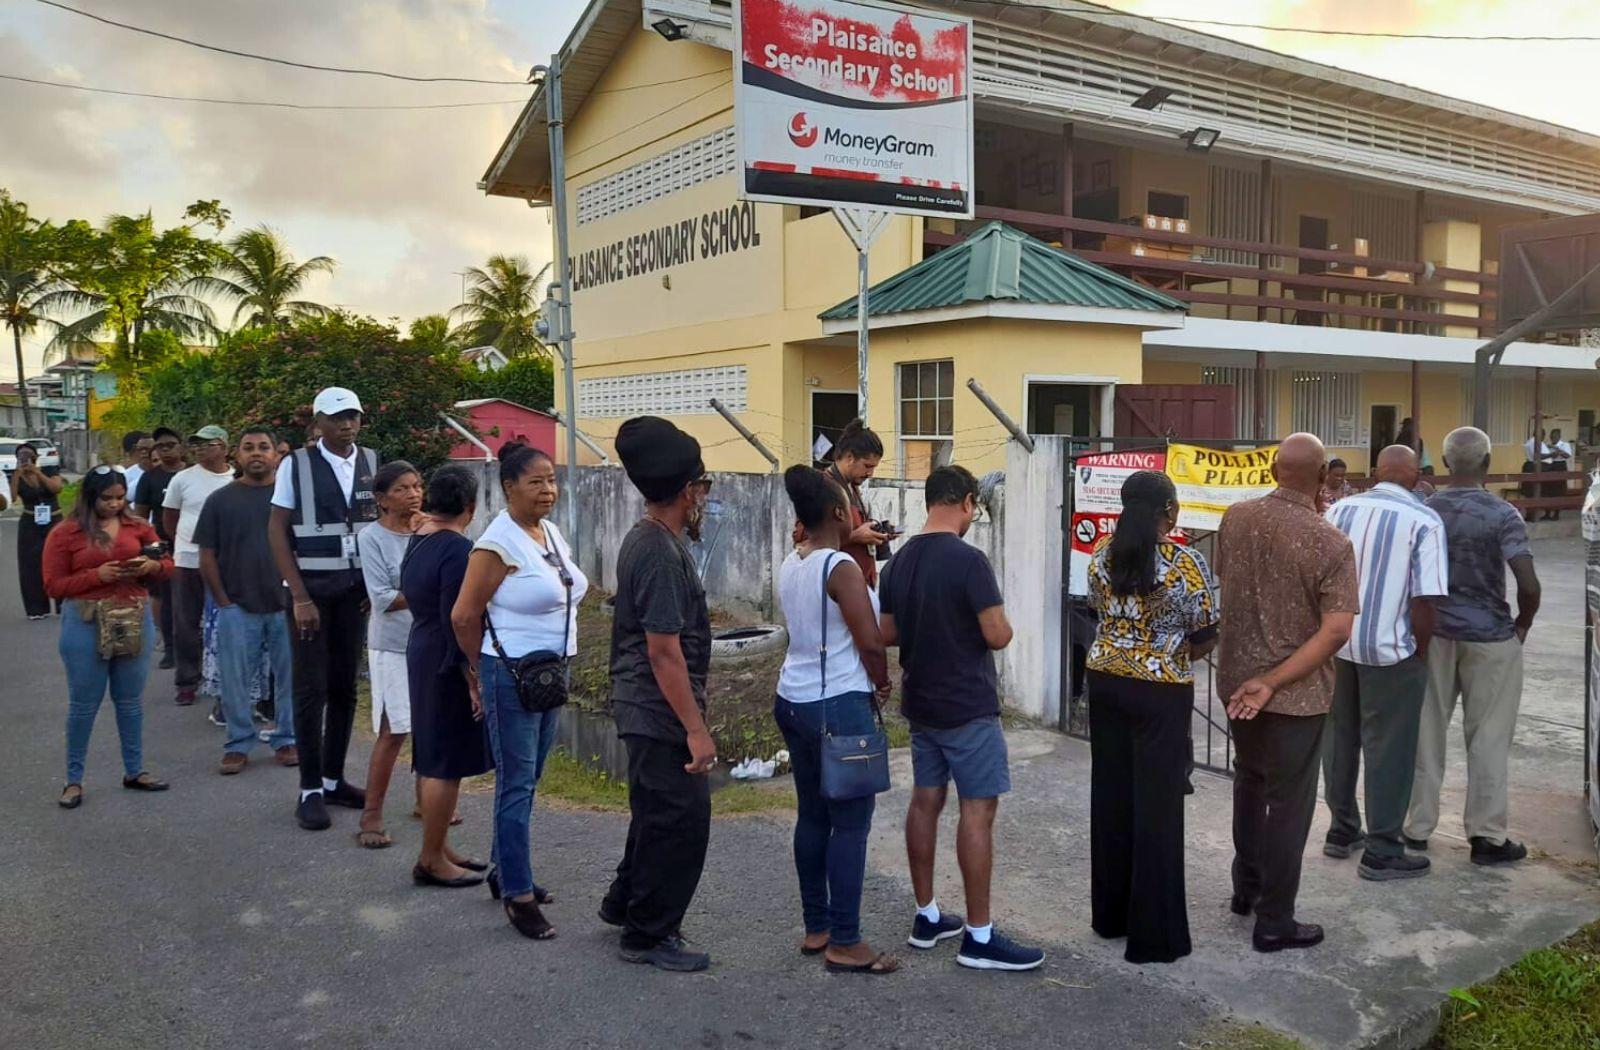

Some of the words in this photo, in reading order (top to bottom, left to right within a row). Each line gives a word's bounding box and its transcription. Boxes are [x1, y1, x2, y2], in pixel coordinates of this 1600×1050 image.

[811, 18, 917, 60] Plaisance
[764, 43, 880, 90] Secondary
[889, 63, 954, 97] School
[823, 126, 935, 158] MoneyGram
[824, 153, 861, 168] money
[863, 156, 905, 171] transfer
[895, 193, 918, 203] Please
[918, 195, 935, 204] Drive
[936, 197, 964, 208] Carefully
[568, 240, 624, 292] PLAISANCE
[626, 217, 699, 278] SECONDARY
[701, 200, 760, 260] SCHOOL
[1088, 453, 1155, 468] WARNING
[1204, 468, 1272, 485] PLACE
